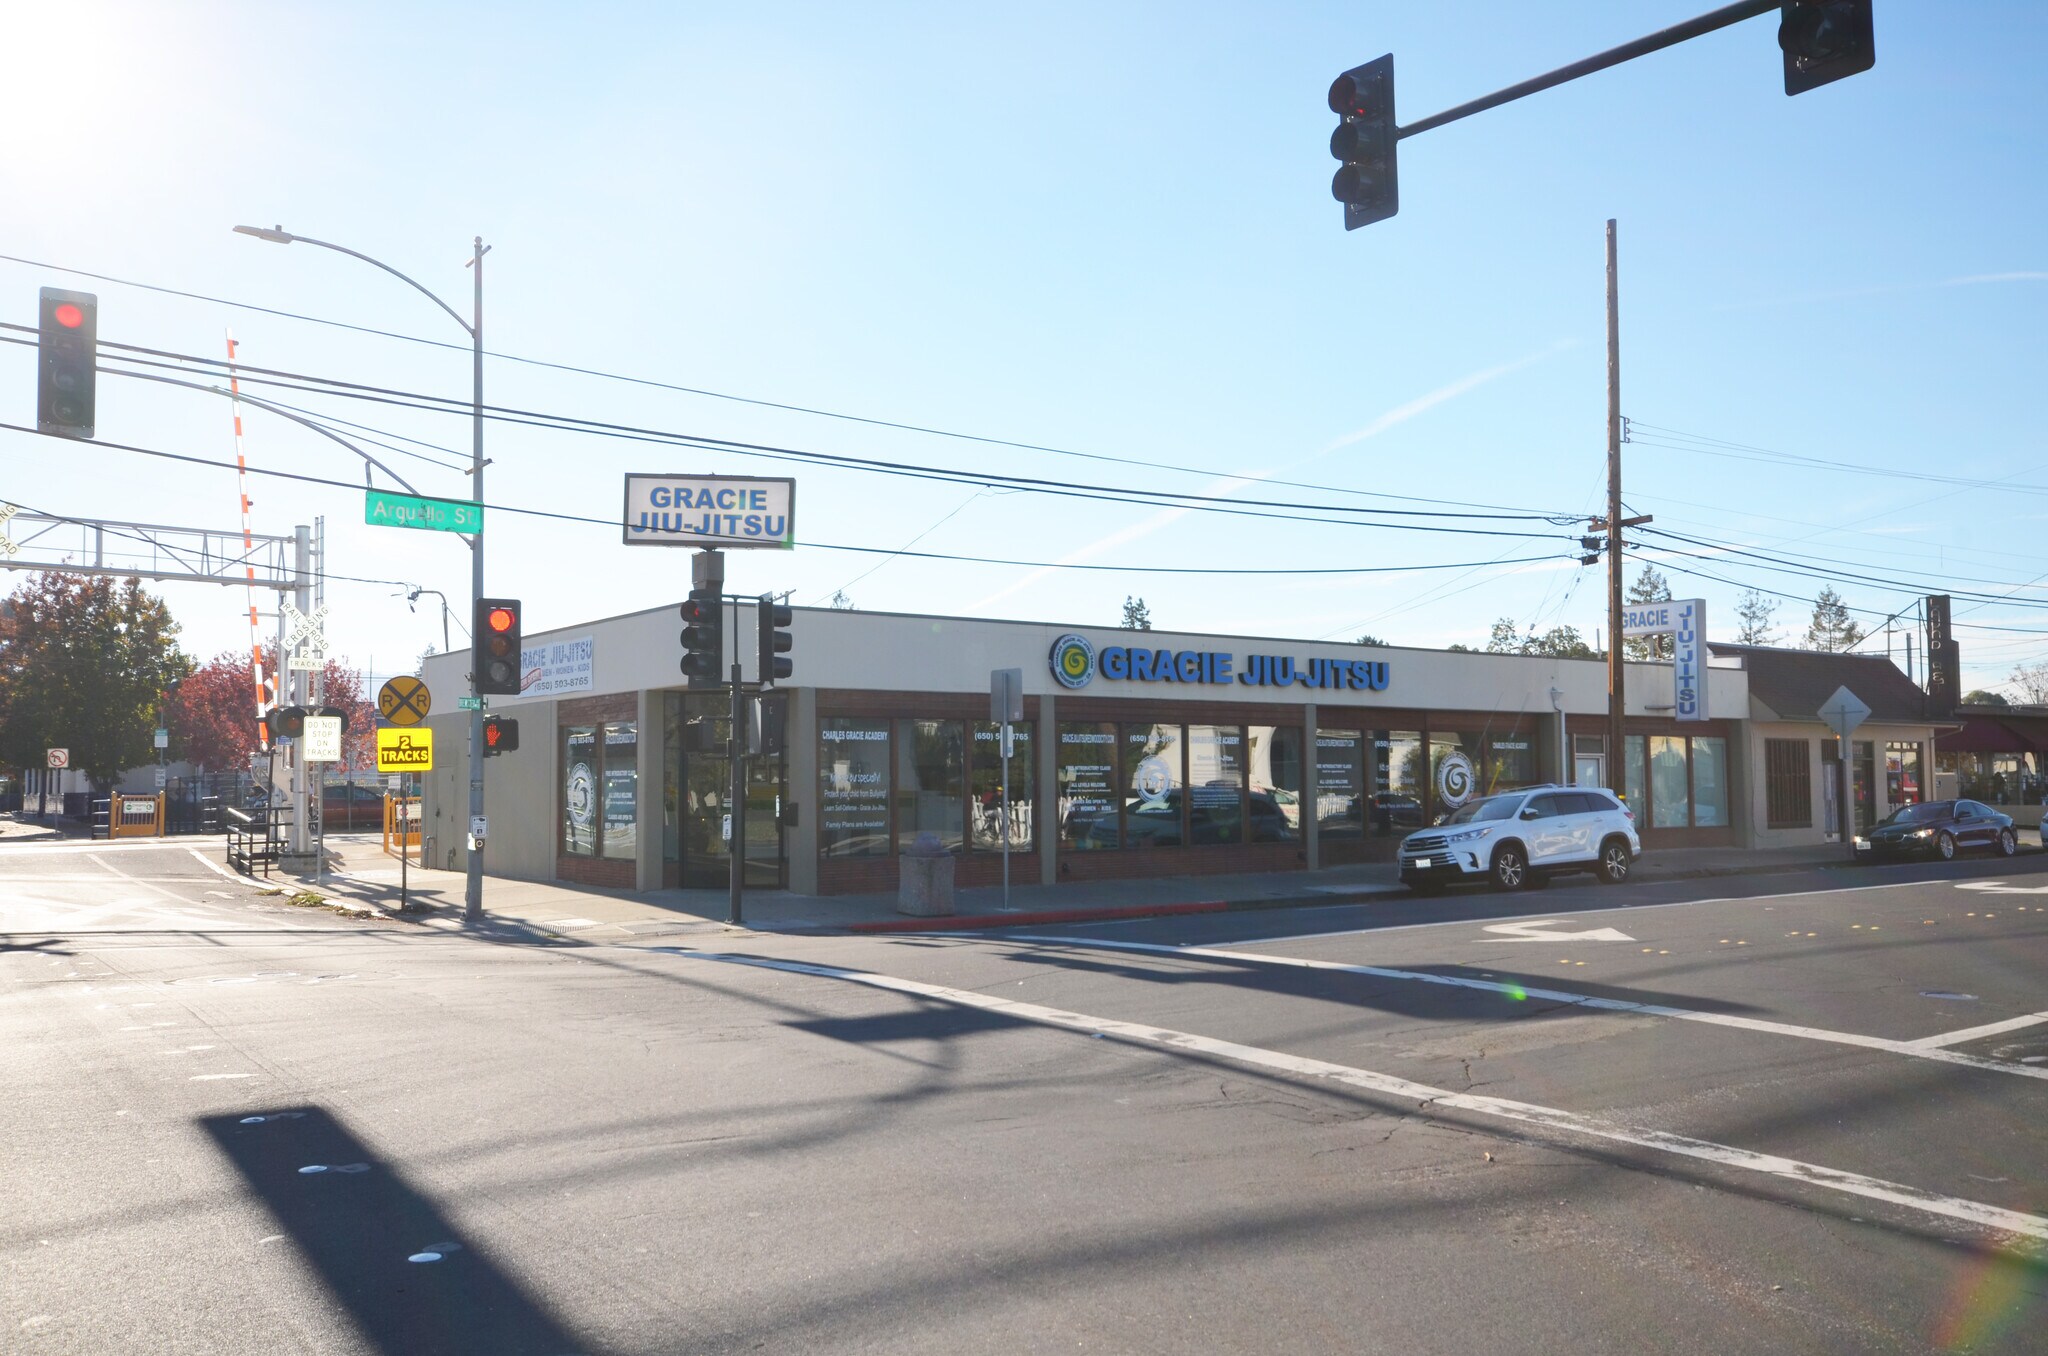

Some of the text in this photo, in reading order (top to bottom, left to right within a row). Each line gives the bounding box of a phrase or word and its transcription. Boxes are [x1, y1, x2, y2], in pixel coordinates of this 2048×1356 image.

[650, 487, 767, 510] GRACIE
[373, 500, 446, 525] Arguello
[631, 512, 785, 536] JIU-JITSU
[283, 602, 330, 650] RAIL ROAD
[285, 606, 329, 647] CROSSING
[302, 649, 309, 659] 2
[520, 639, 593, 669] RACIE JIU-JITSU
[1678, 605, 1696, 715] JIU-JITSU
[290, 660, 323, 668] TRACKS
[1101, 646, 1390, 691] GRACIE JIU-JITSU
[554, 676, 589, 689] 503-8765
[382, 694, 428, 707] R R
[308, 721, 337, 729] DO NOT
[312, 730, 333, 738] STOP
[823, 730, 889, 740] CHARLES GRACIE ACADEMY
[974, 732, 994, 741] (650)
[316, 739, 328, 747] ON
[400, 737, 410, 750] 2
[307, 748, 338, 756] TRACKS
[382, 750, 428, 763] TRACKS
